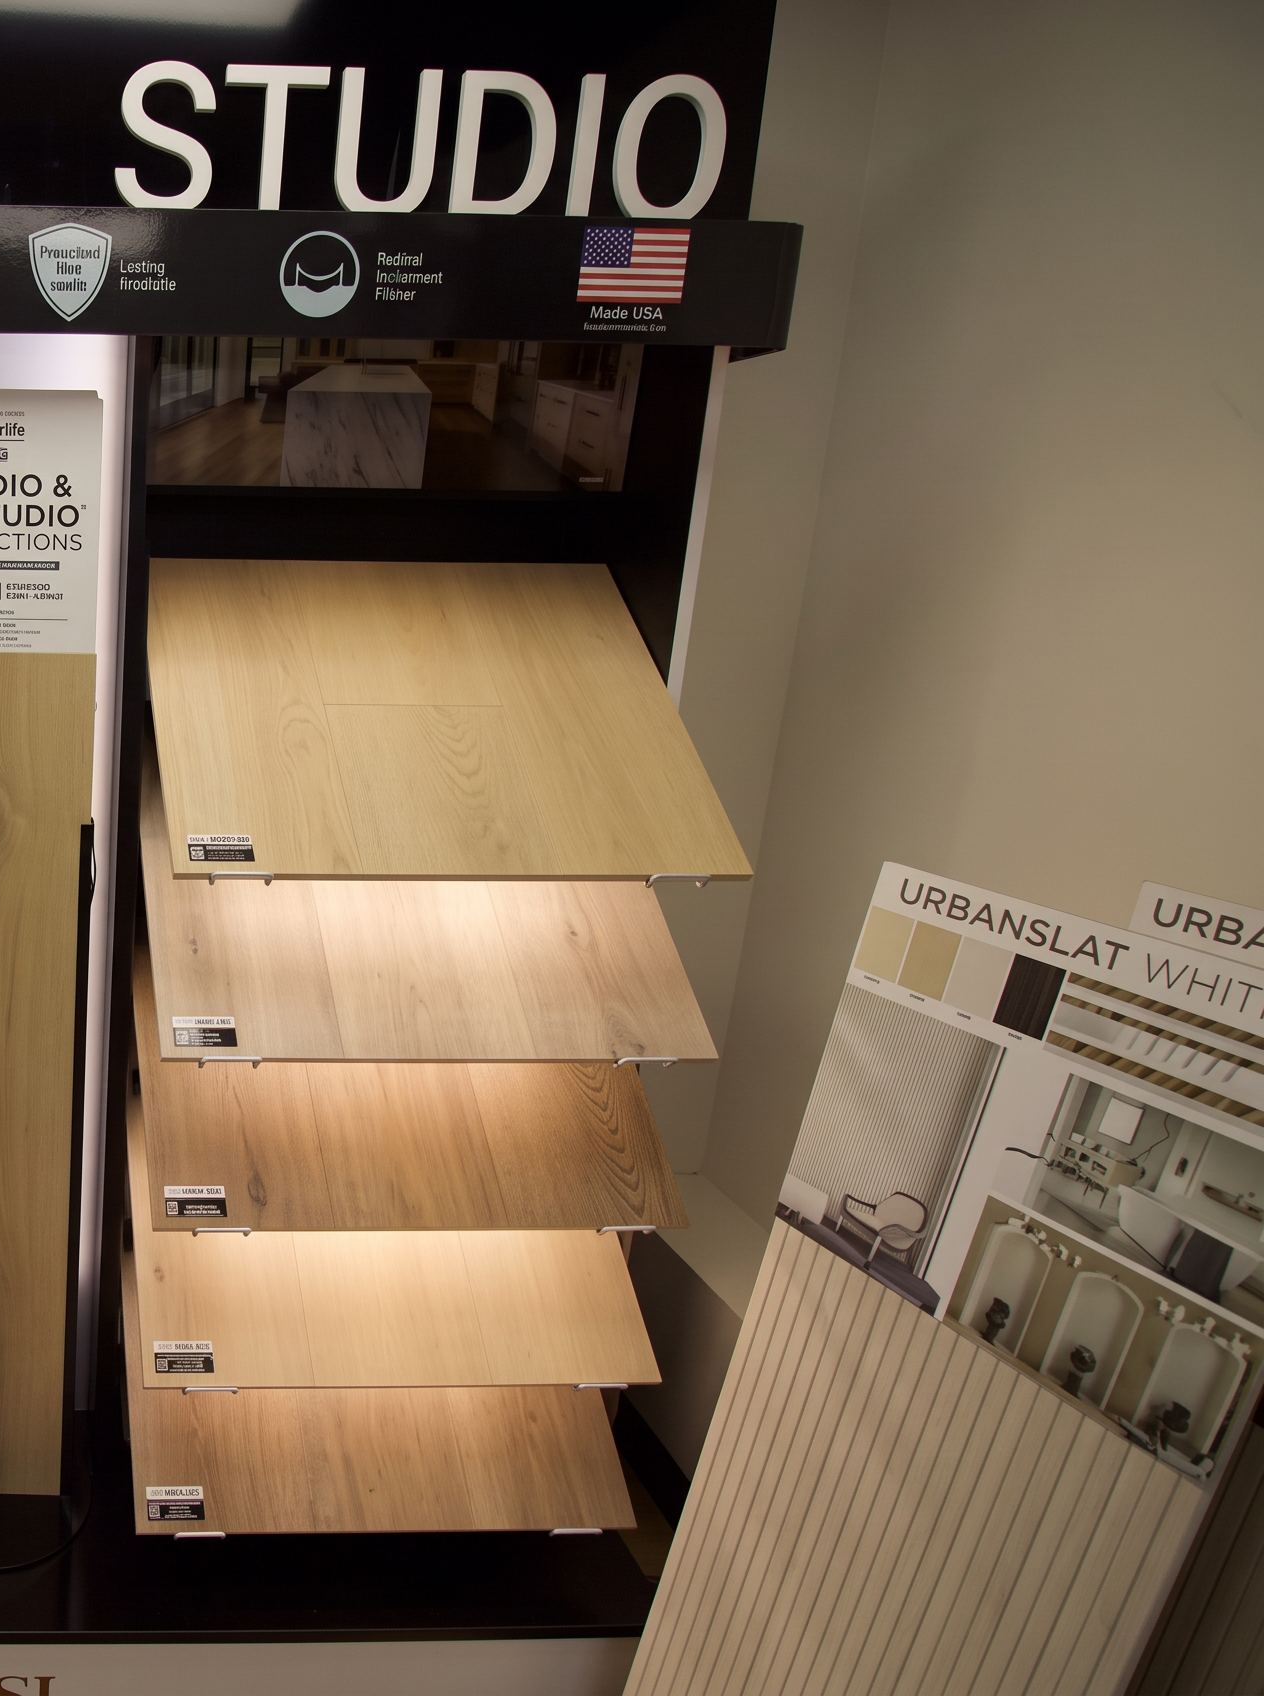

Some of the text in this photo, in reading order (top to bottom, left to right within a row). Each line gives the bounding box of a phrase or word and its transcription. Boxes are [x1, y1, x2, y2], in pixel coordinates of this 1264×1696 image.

[114, 60, 727, 219] STUDIO
[120, 259, 165, 277] Lesting
[589, 306, 663, 320] Made USA
[52, 474, 72, 497] &
[898, 877, 1264, 1020] URBANSLAT WHIT
